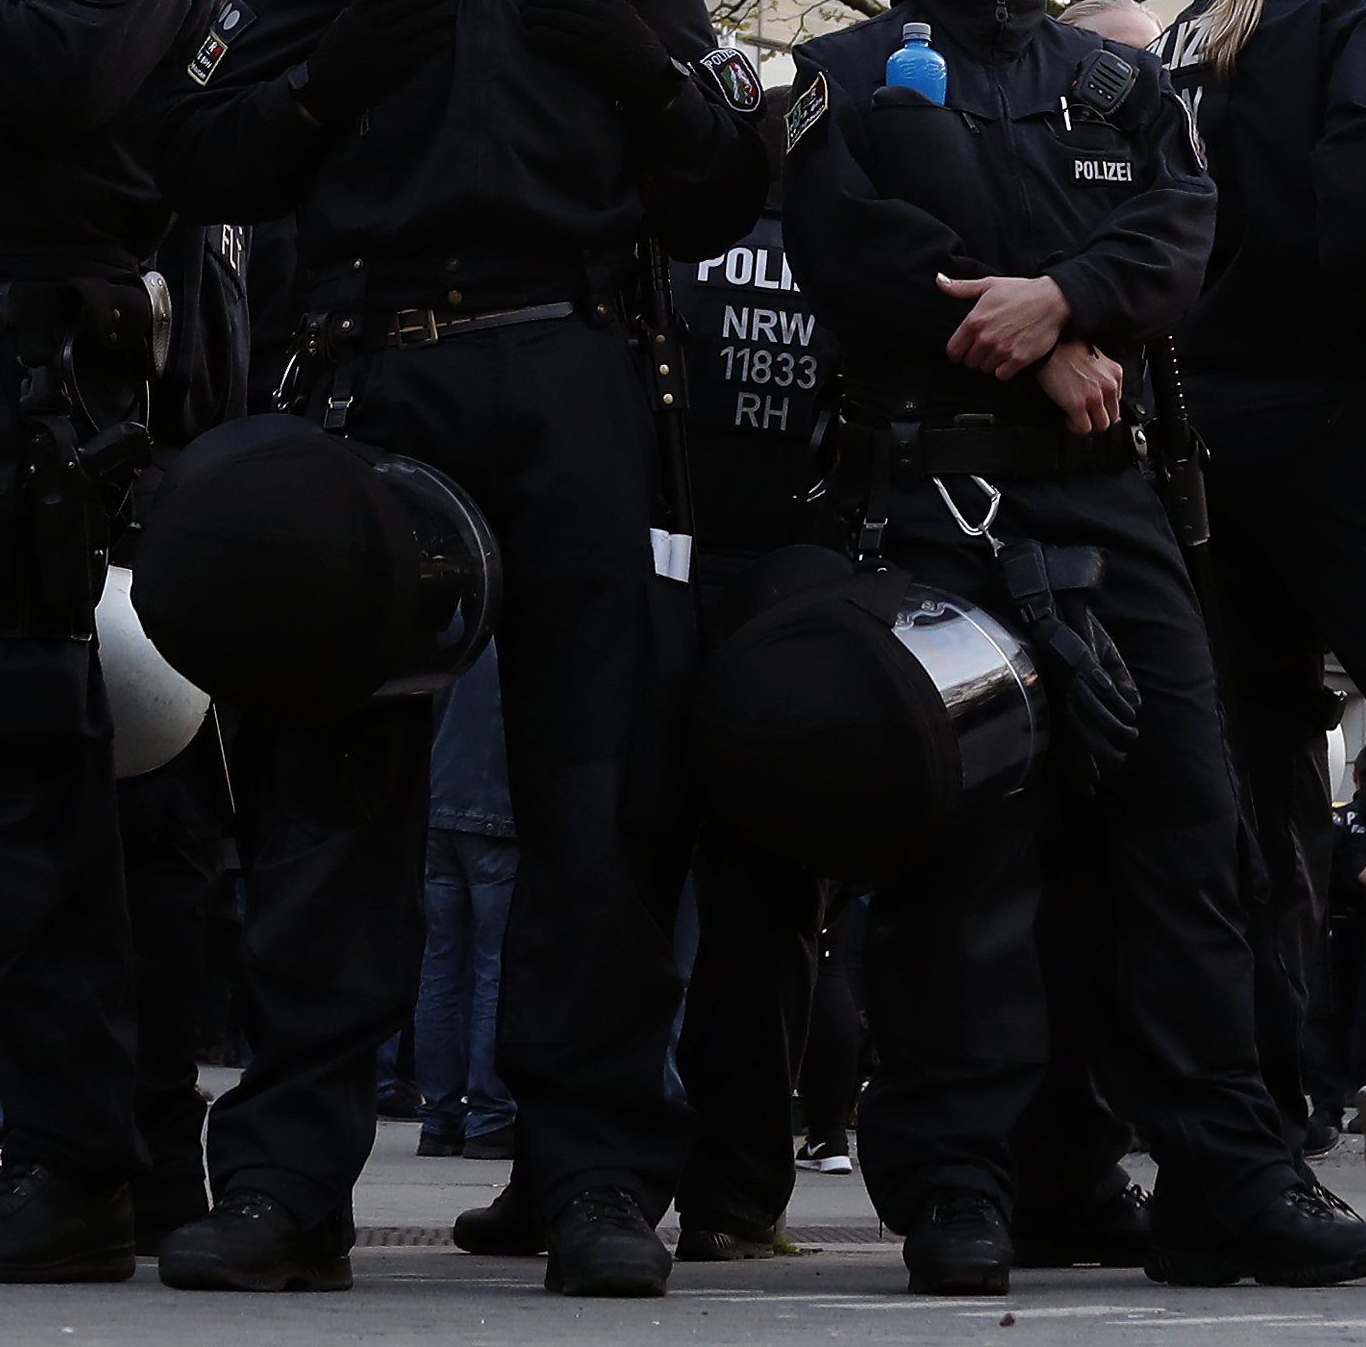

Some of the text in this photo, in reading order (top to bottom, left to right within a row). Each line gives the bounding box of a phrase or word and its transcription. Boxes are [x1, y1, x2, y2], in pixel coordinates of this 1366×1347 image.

[1074, 159, 1132, 182] POLIZEI
[722, 305, 816, 347] NRW
[720, 346, 818, 390] 11833
[735, 391, 790, 431] RH
